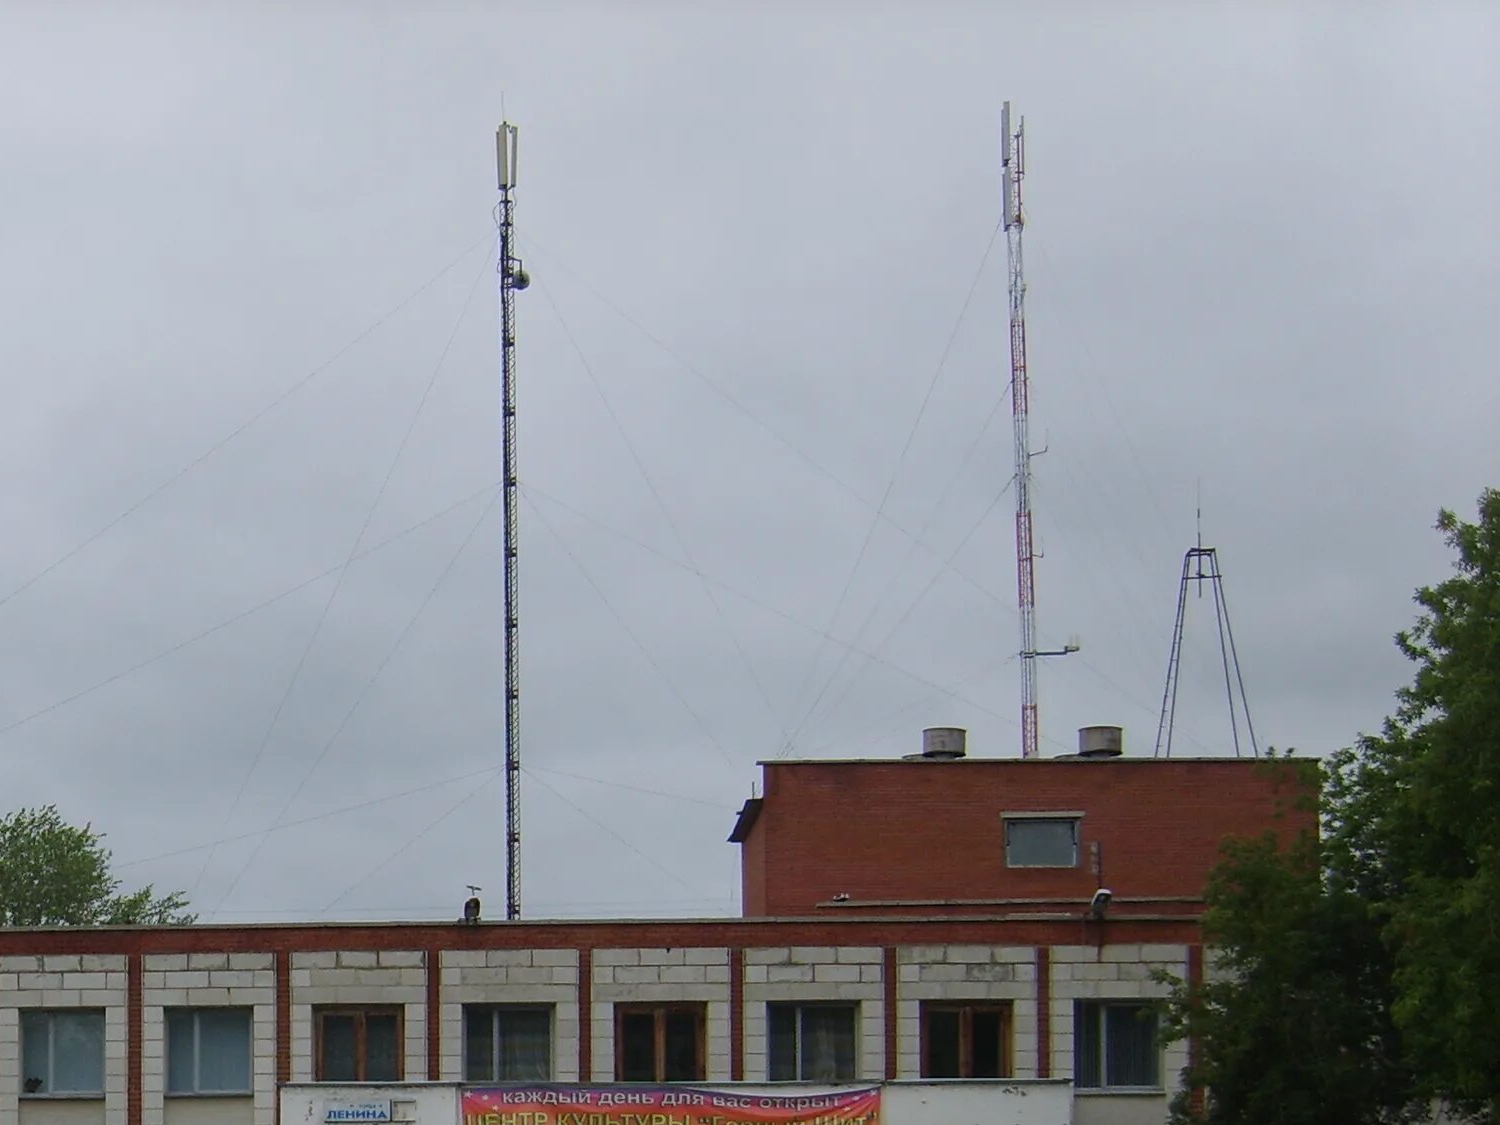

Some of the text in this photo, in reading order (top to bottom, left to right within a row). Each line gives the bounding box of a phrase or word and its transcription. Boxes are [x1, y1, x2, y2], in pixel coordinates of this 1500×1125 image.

[503, 1090, 841, 1111] каждый день для вас открыт
[327, 1110, 387, 1119] ЛЕНИНА
